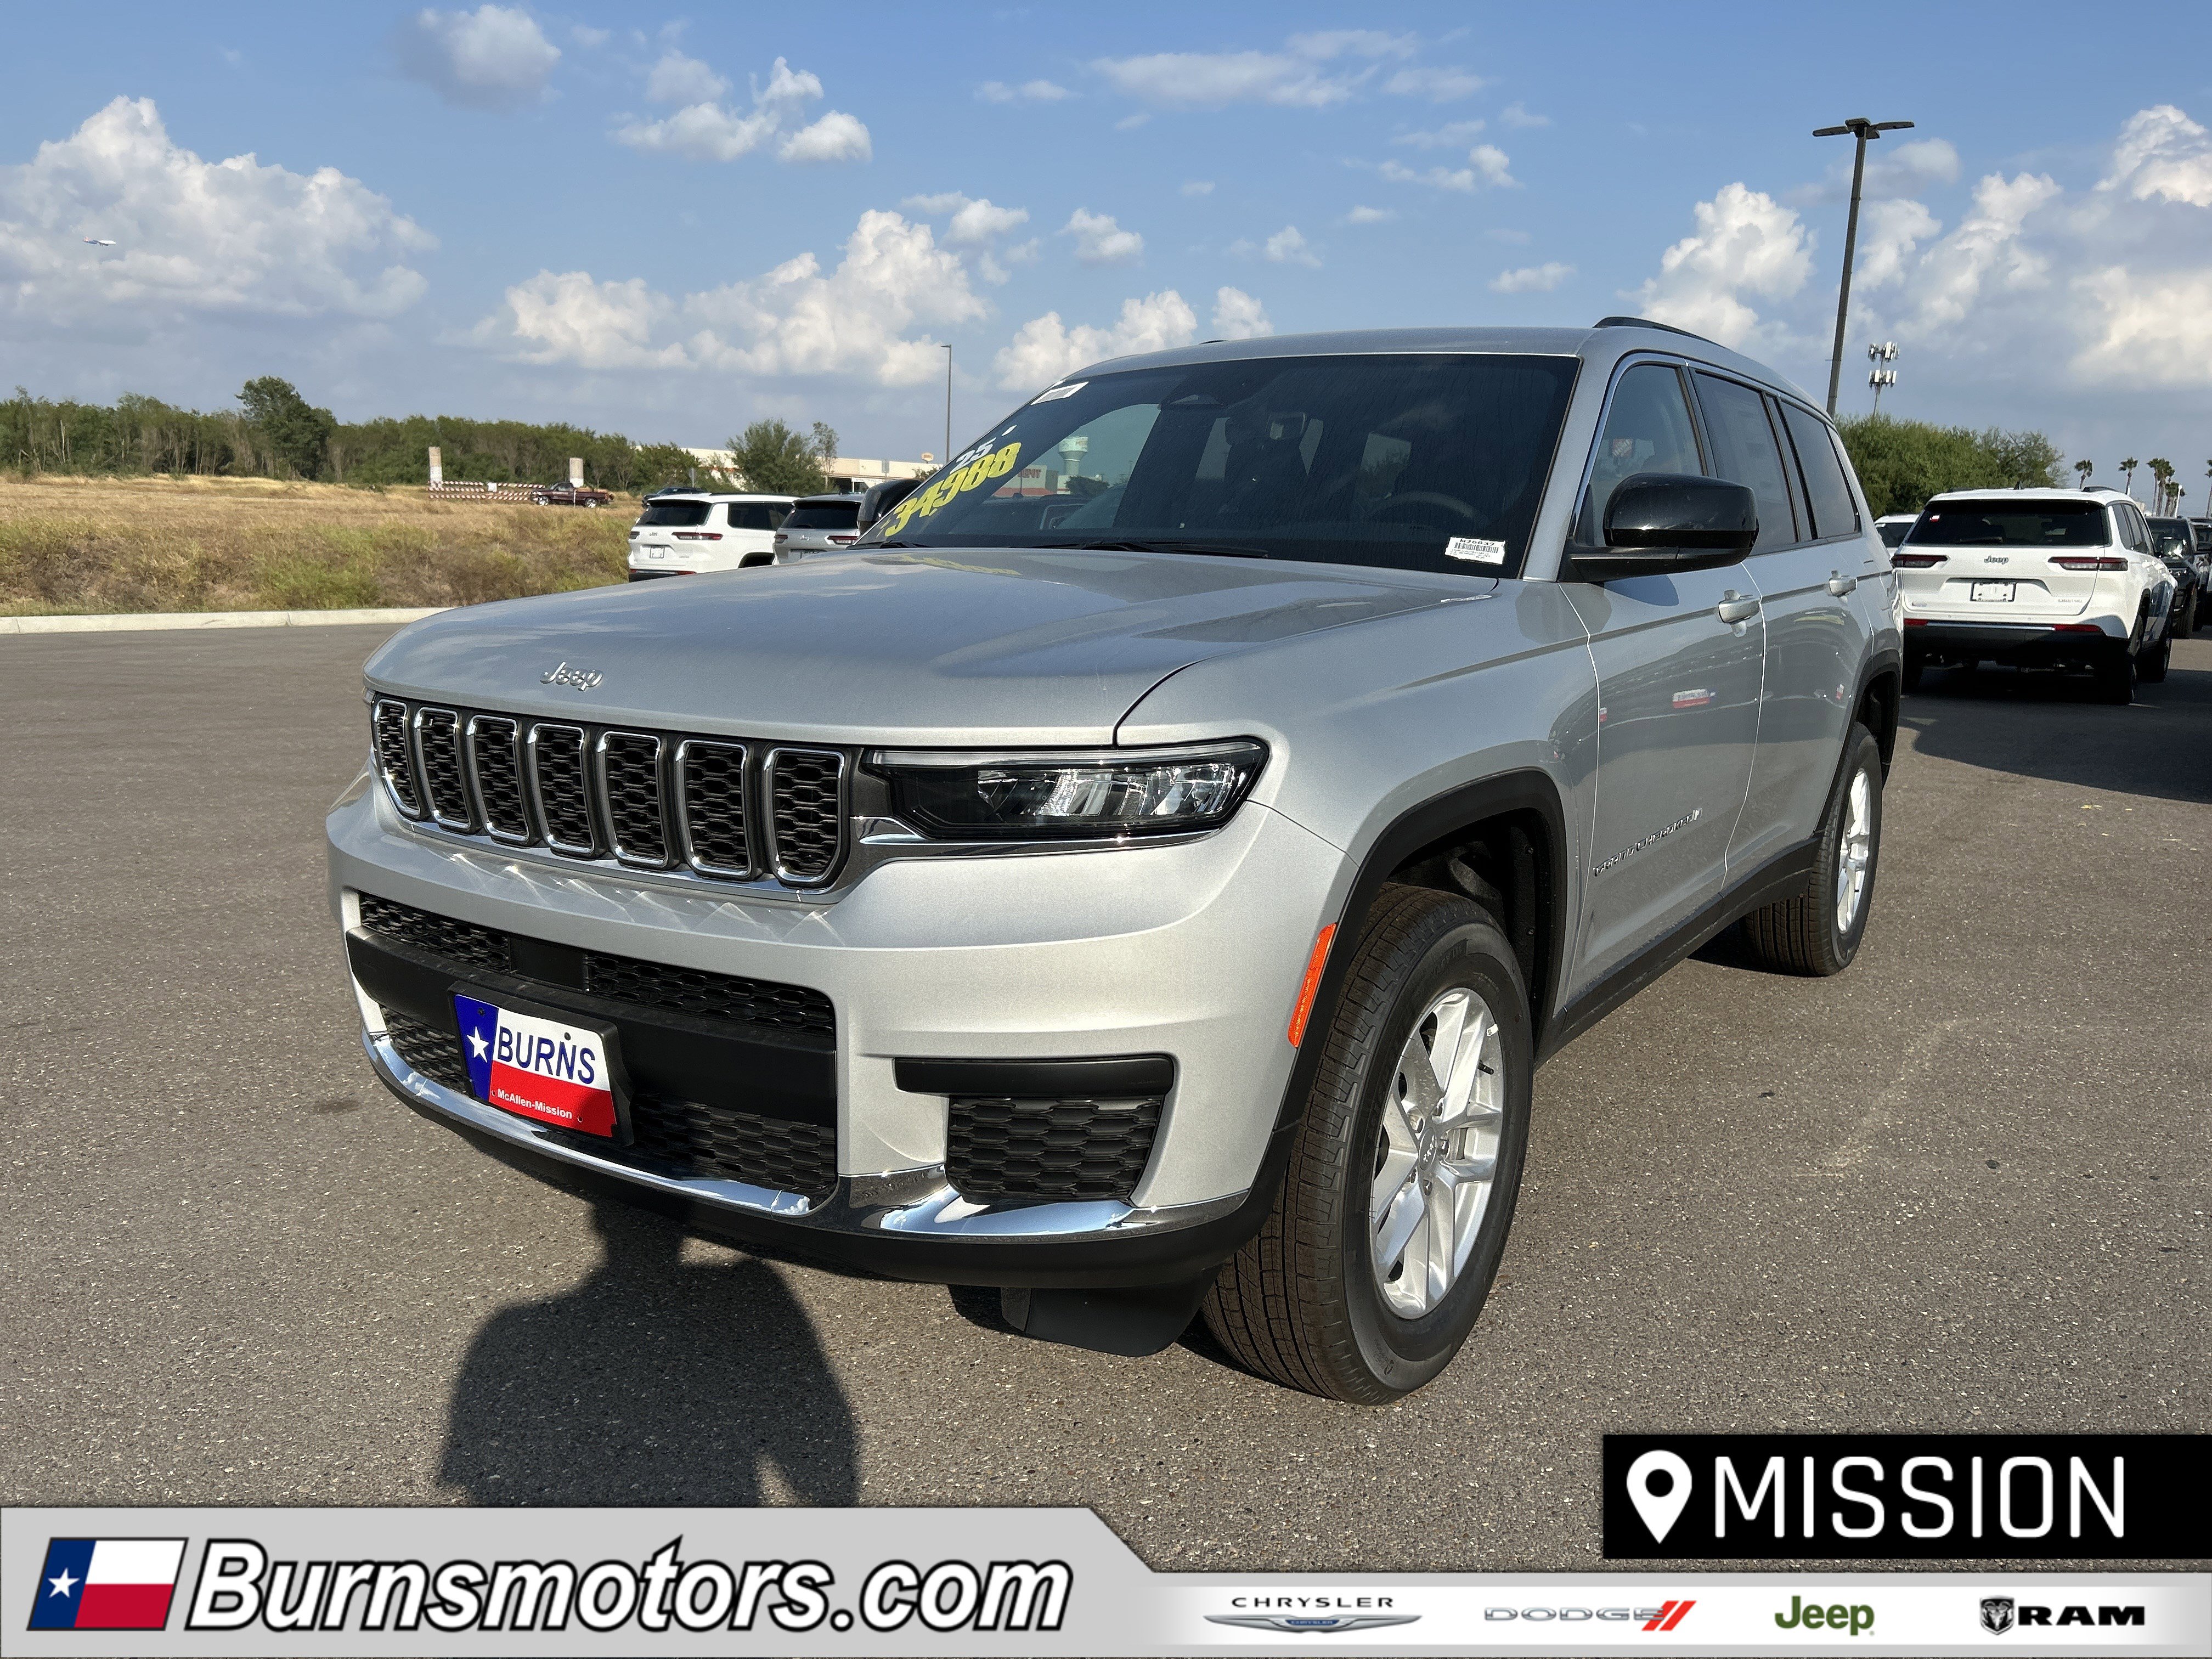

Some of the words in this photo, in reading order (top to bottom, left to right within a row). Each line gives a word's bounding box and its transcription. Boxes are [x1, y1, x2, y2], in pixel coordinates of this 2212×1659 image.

[539, 661, 603, 692] Jeep
[497, 1025, 596, 1085] BURNS
[497, 1088, 572, 1119] McAllen-Mission
